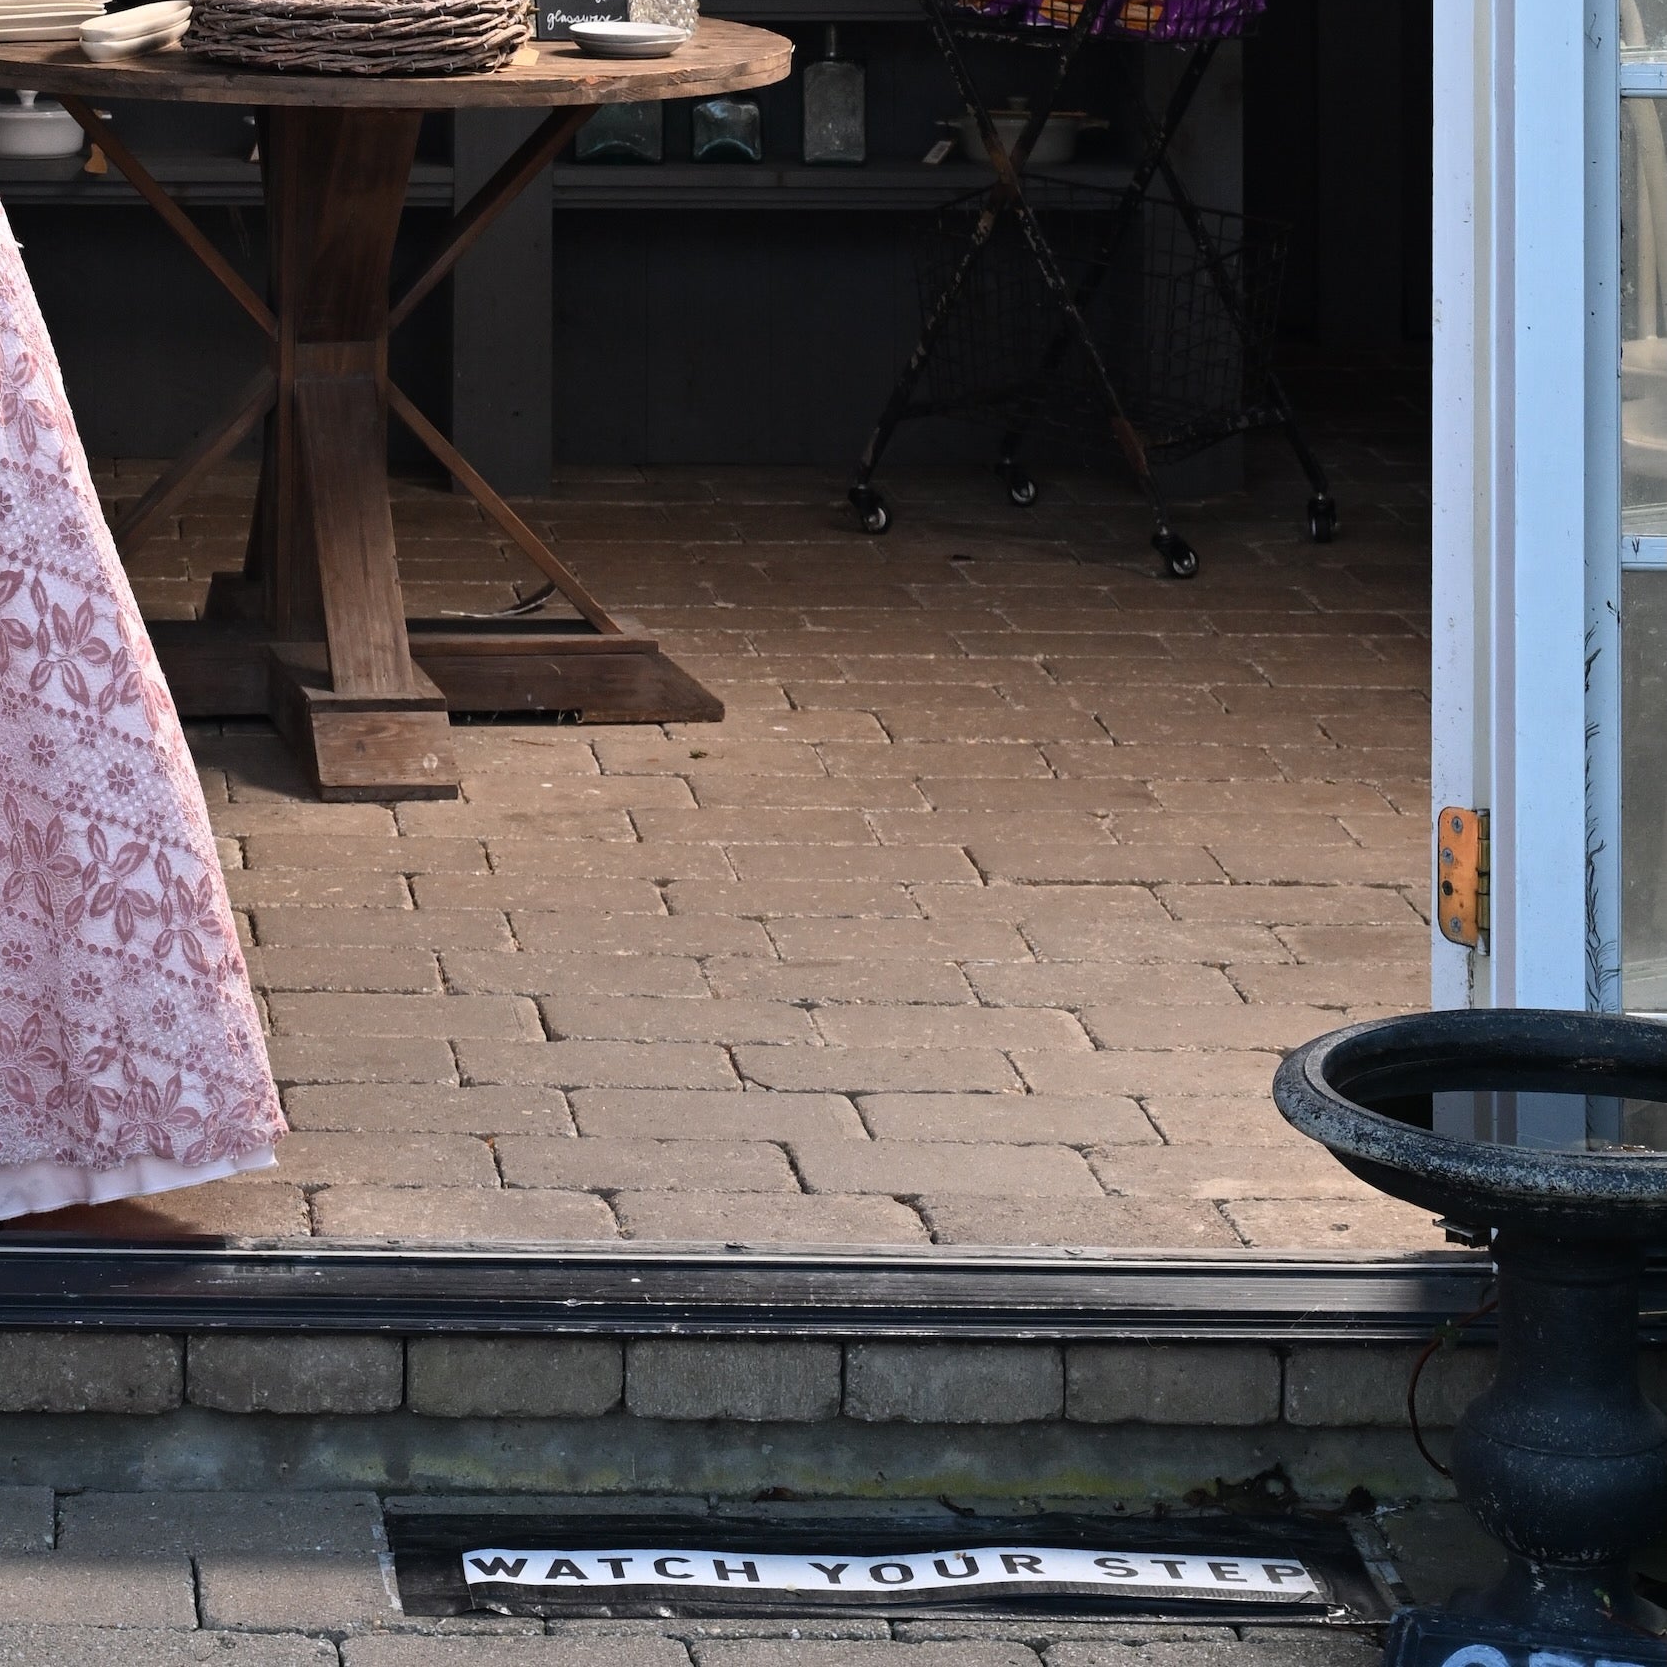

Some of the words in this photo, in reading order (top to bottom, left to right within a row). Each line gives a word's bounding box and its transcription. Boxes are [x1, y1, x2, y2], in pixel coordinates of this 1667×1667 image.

[546, 9, 623, 31] glassware
[468, 1556, 761, 1583] WATCH
[808, 1553, 1047, 1586] YOUR
[1093, 1557, 1306, 1585] STEP
